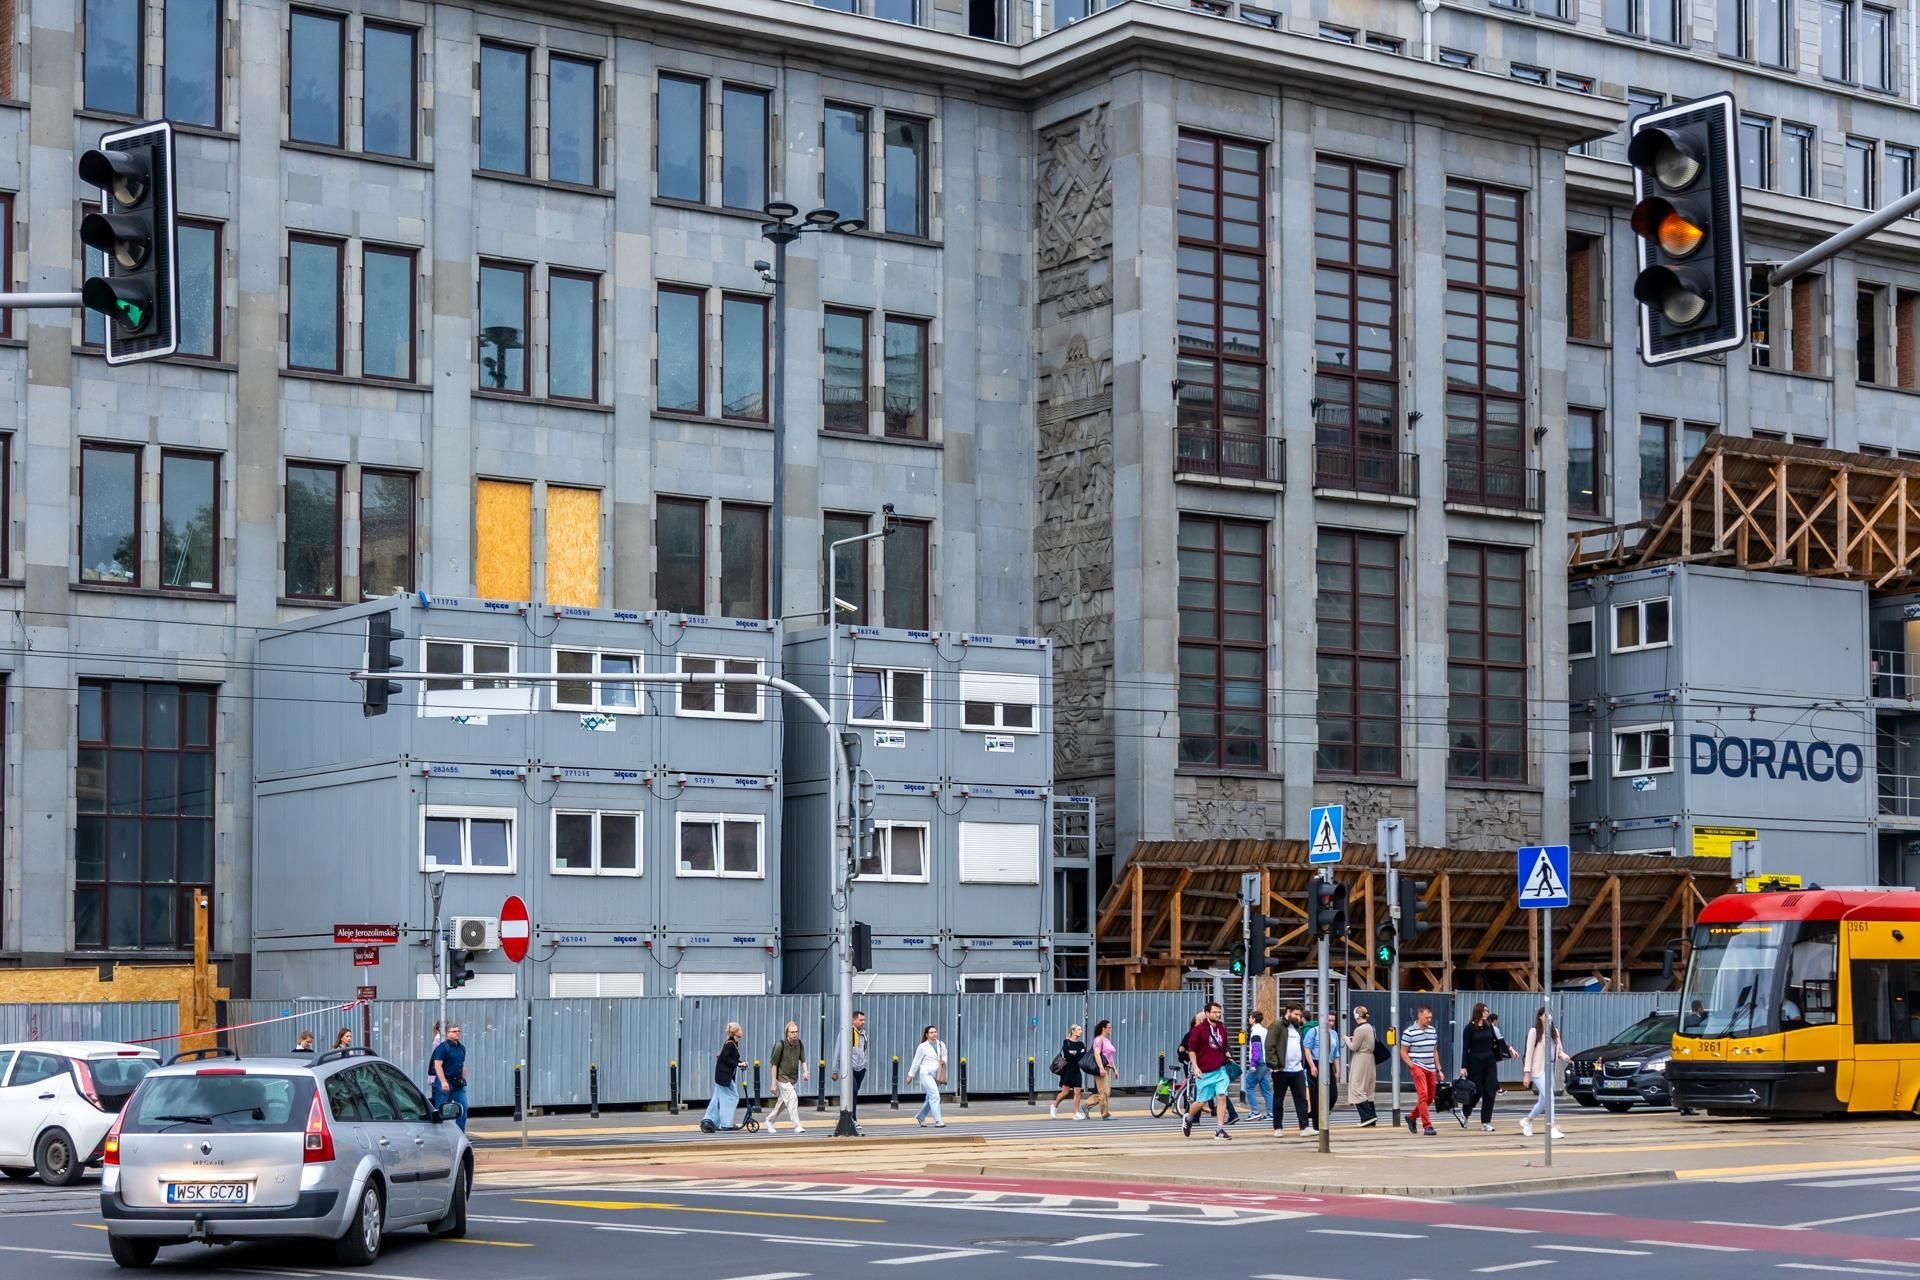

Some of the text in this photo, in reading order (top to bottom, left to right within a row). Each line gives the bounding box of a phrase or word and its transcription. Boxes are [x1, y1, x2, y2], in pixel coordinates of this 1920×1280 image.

[1690, 734, 1864, 783] DORACO
[338, 929, 396, 938] Aleje Jerozolimskie
[1698, 1042, 1721, 1051] 3261
[177, 1185, 244, 1199] WSK GC78
